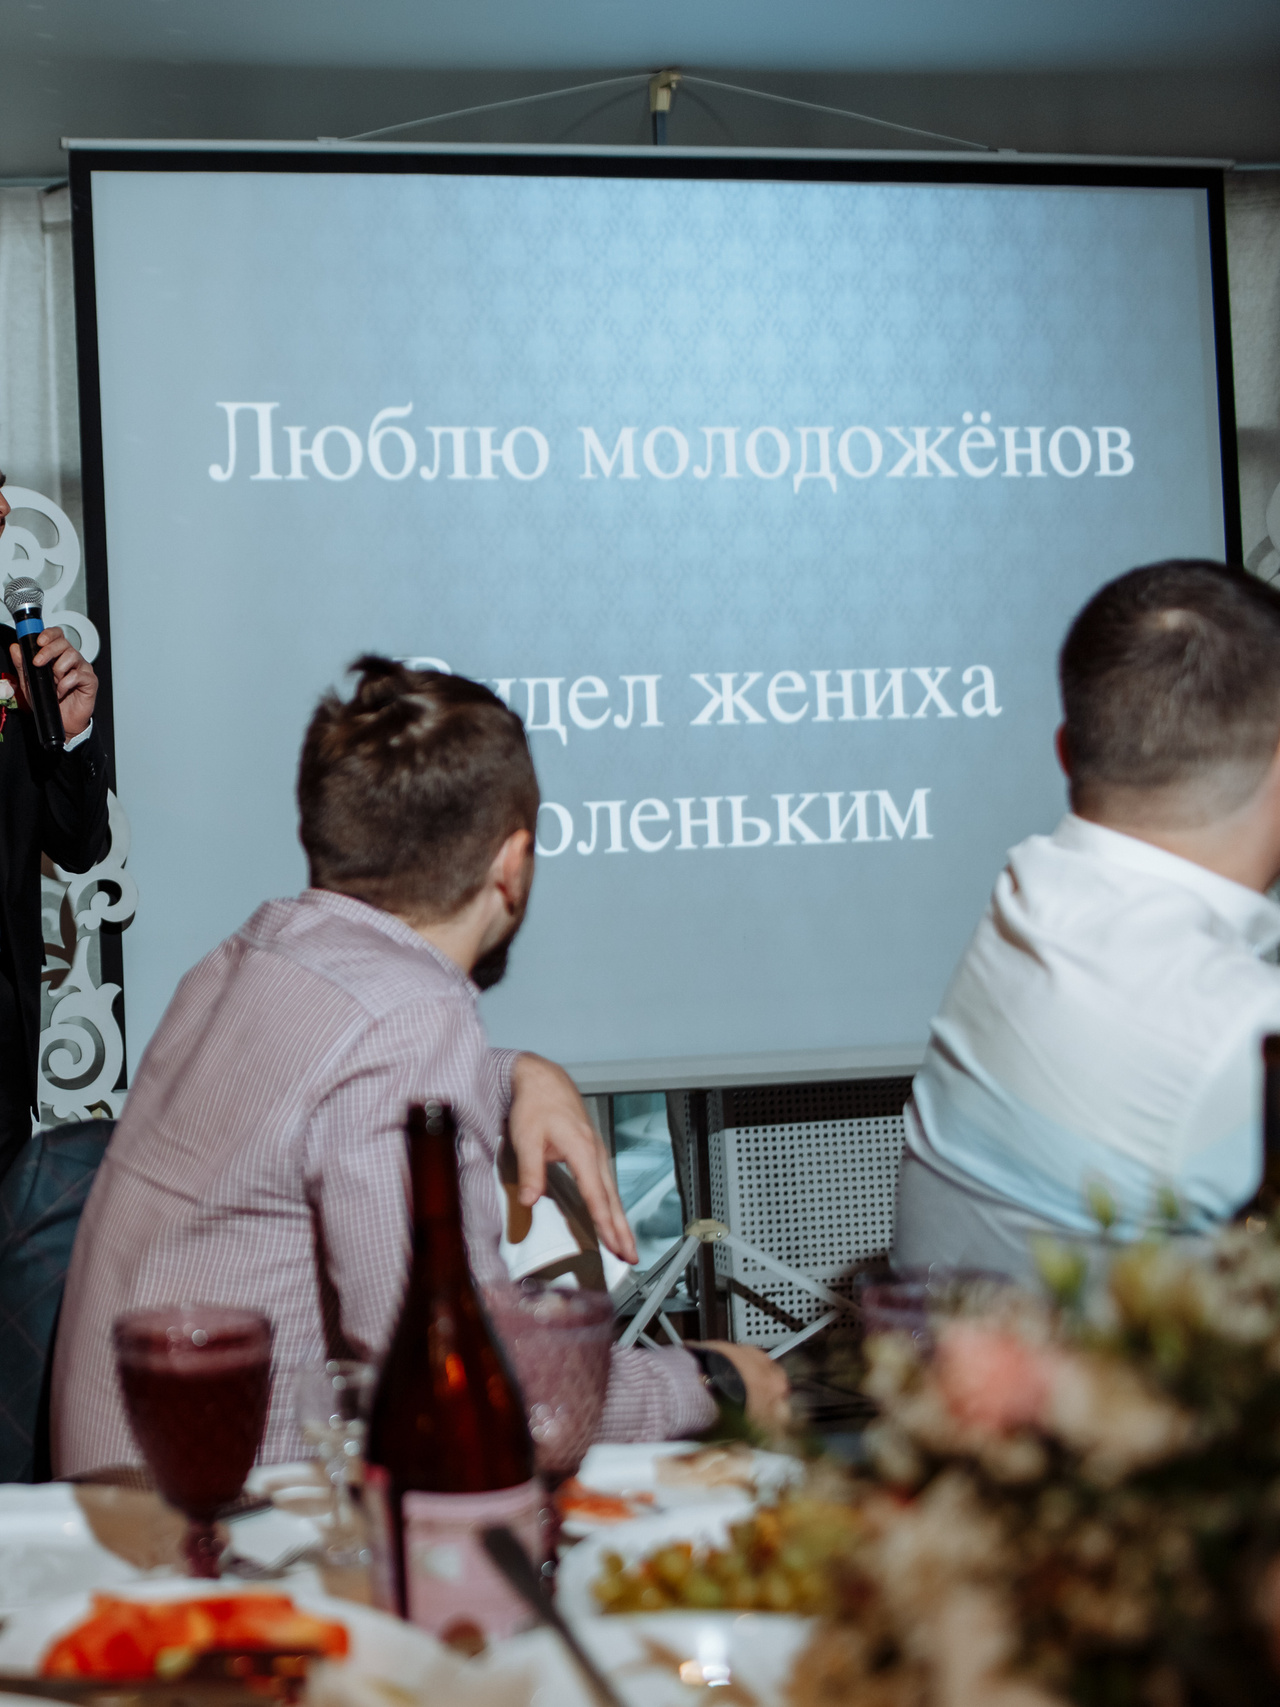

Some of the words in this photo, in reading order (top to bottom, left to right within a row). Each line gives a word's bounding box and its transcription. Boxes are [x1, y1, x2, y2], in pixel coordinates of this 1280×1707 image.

[209, 401, 550, 482] Люблю
[582, 411, 1135, 493] молодожёнов
[392, 656, 663, 745] дел
[691, 661, 1003, 725] жениха
[534, 787, 932, 857] оленьким
